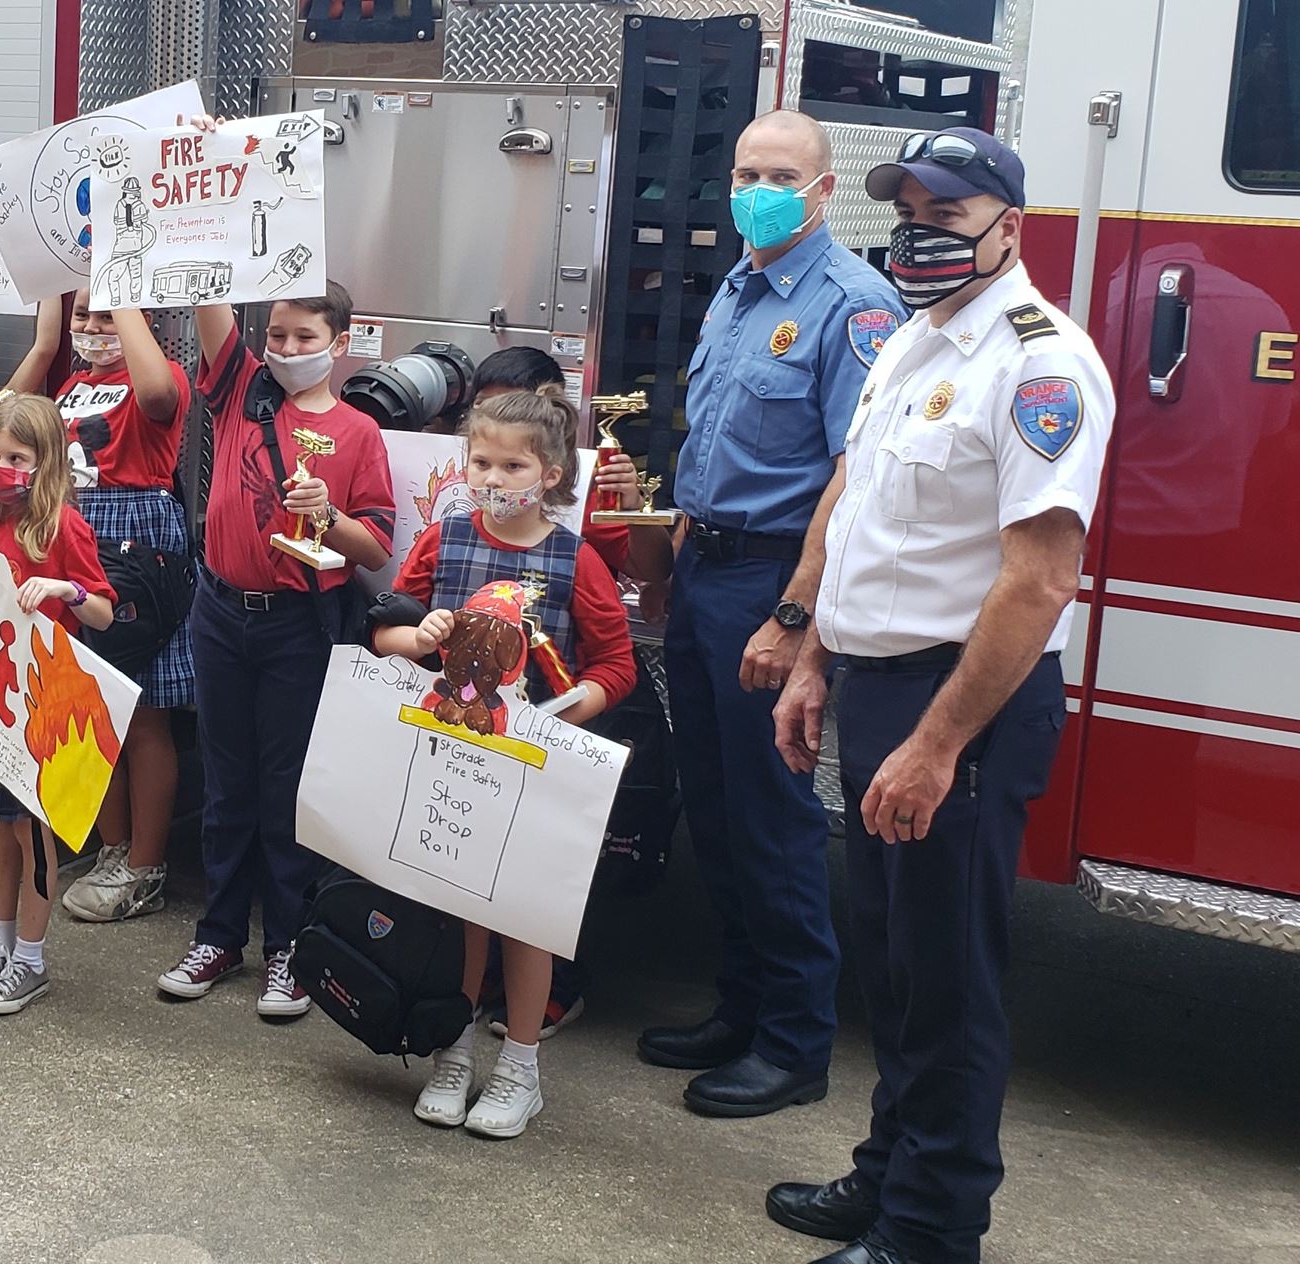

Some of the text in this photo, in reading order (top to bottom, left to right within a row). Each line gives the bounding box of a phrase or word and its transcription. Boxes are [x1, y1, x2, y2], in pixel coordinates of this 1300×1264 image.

[34, 168, 71, 213] Stay
[152, 162, 248, 208] SAFETY
[177, 215, 215, 231] Prevention
[50, 229, 67, 246] and
[166, 233, 206, 247] Everyones
[90, 389, 125, 405] LOVE
[1020, 383, 1069, 400] ORANGE
[350, 646, 380, 681] Fire
[514, 705, 578, 751] Clifford
[445, 760, 467, 778] Fire
[451, 743, 486, 767] Grade
[430, 779, 473, 817] Stop
[424, 804, 472, 839] Drop
[419, 829, 459, 861] Roll
